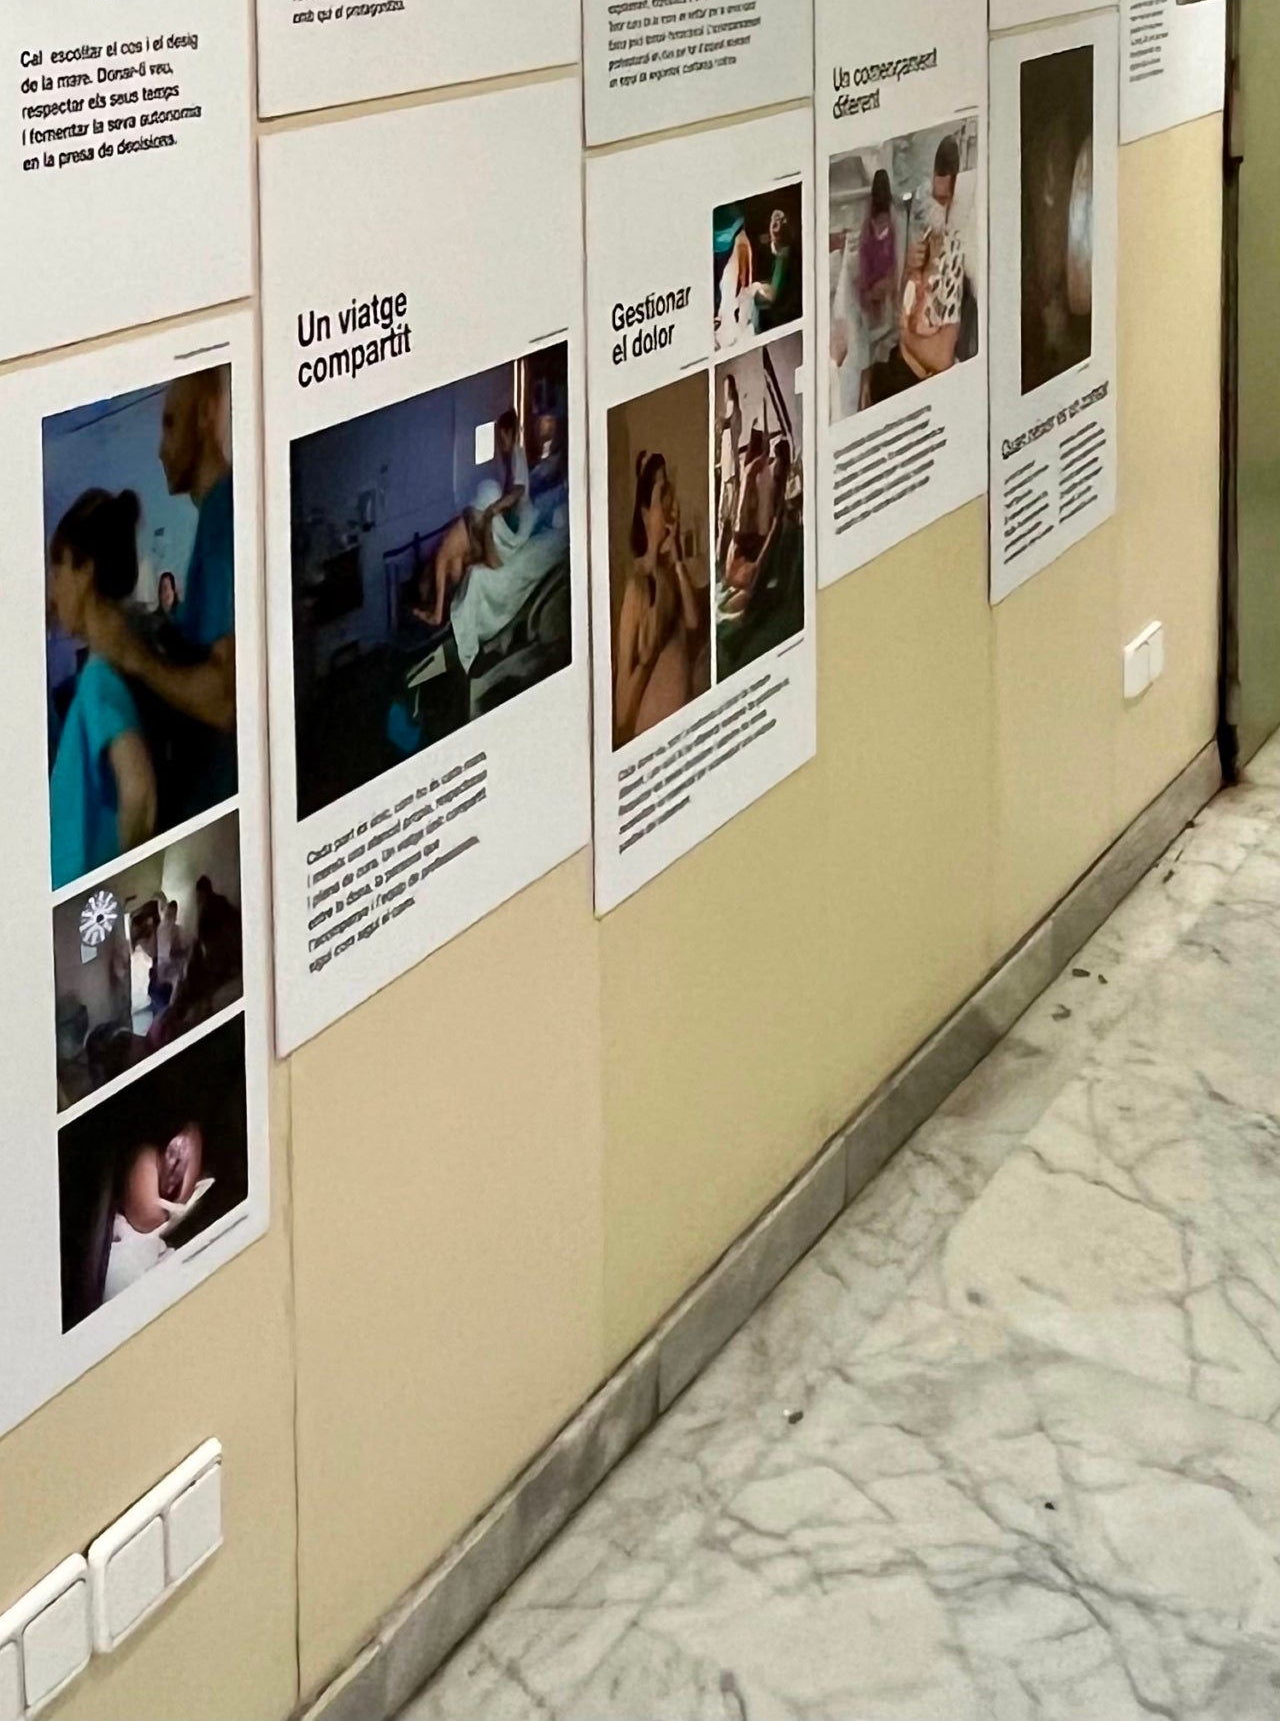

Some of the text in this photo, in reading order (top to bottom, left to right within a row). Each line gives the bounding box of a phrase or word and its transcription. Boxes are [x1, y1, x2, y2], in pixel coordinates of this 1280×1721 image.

[298, 292, 407, 347] Un viatge
[612, 286, 691, 332] Gestionar
[298, 323, 412, 388] compartit
[612, 324, 675, 365] el dolor
